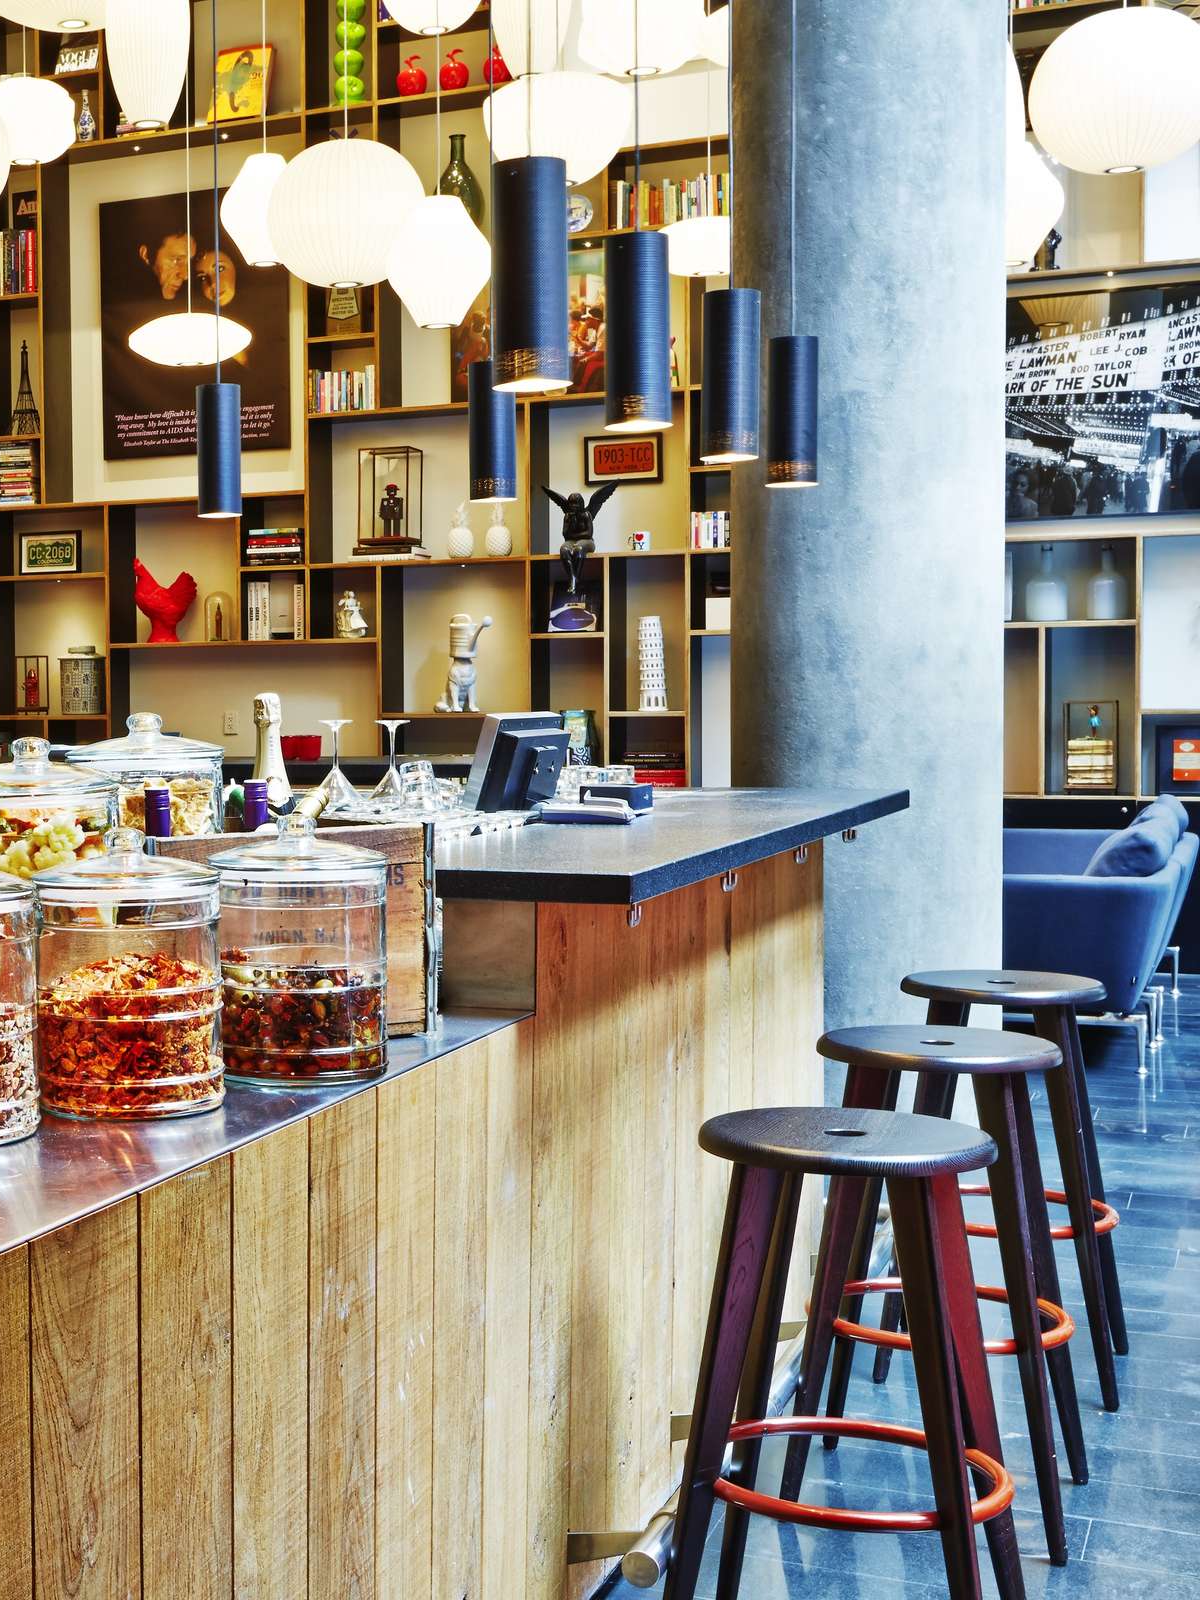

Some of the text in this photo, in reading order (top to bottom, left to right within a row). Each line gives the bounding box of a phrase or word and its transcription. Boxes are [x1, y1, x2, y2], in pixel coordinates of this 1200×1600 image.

[1079, 328, 1119, 342] ROBERT
[1119, 329, 1147, 341] RYAN
[1090, 345, 1109, 356] LEE
[1124, 346, 1148, 357] COB
[1179, 339, 1200, 351] BROW
[1012, 360, 1133, 380] JIM BROWN ROD TAYLOR
[1031, 379, 1049, 392] OF
[1055, 376, 1085, 391] THE
[162, 410, 184, 419] difficult
[260, 411, 272, 420] only
